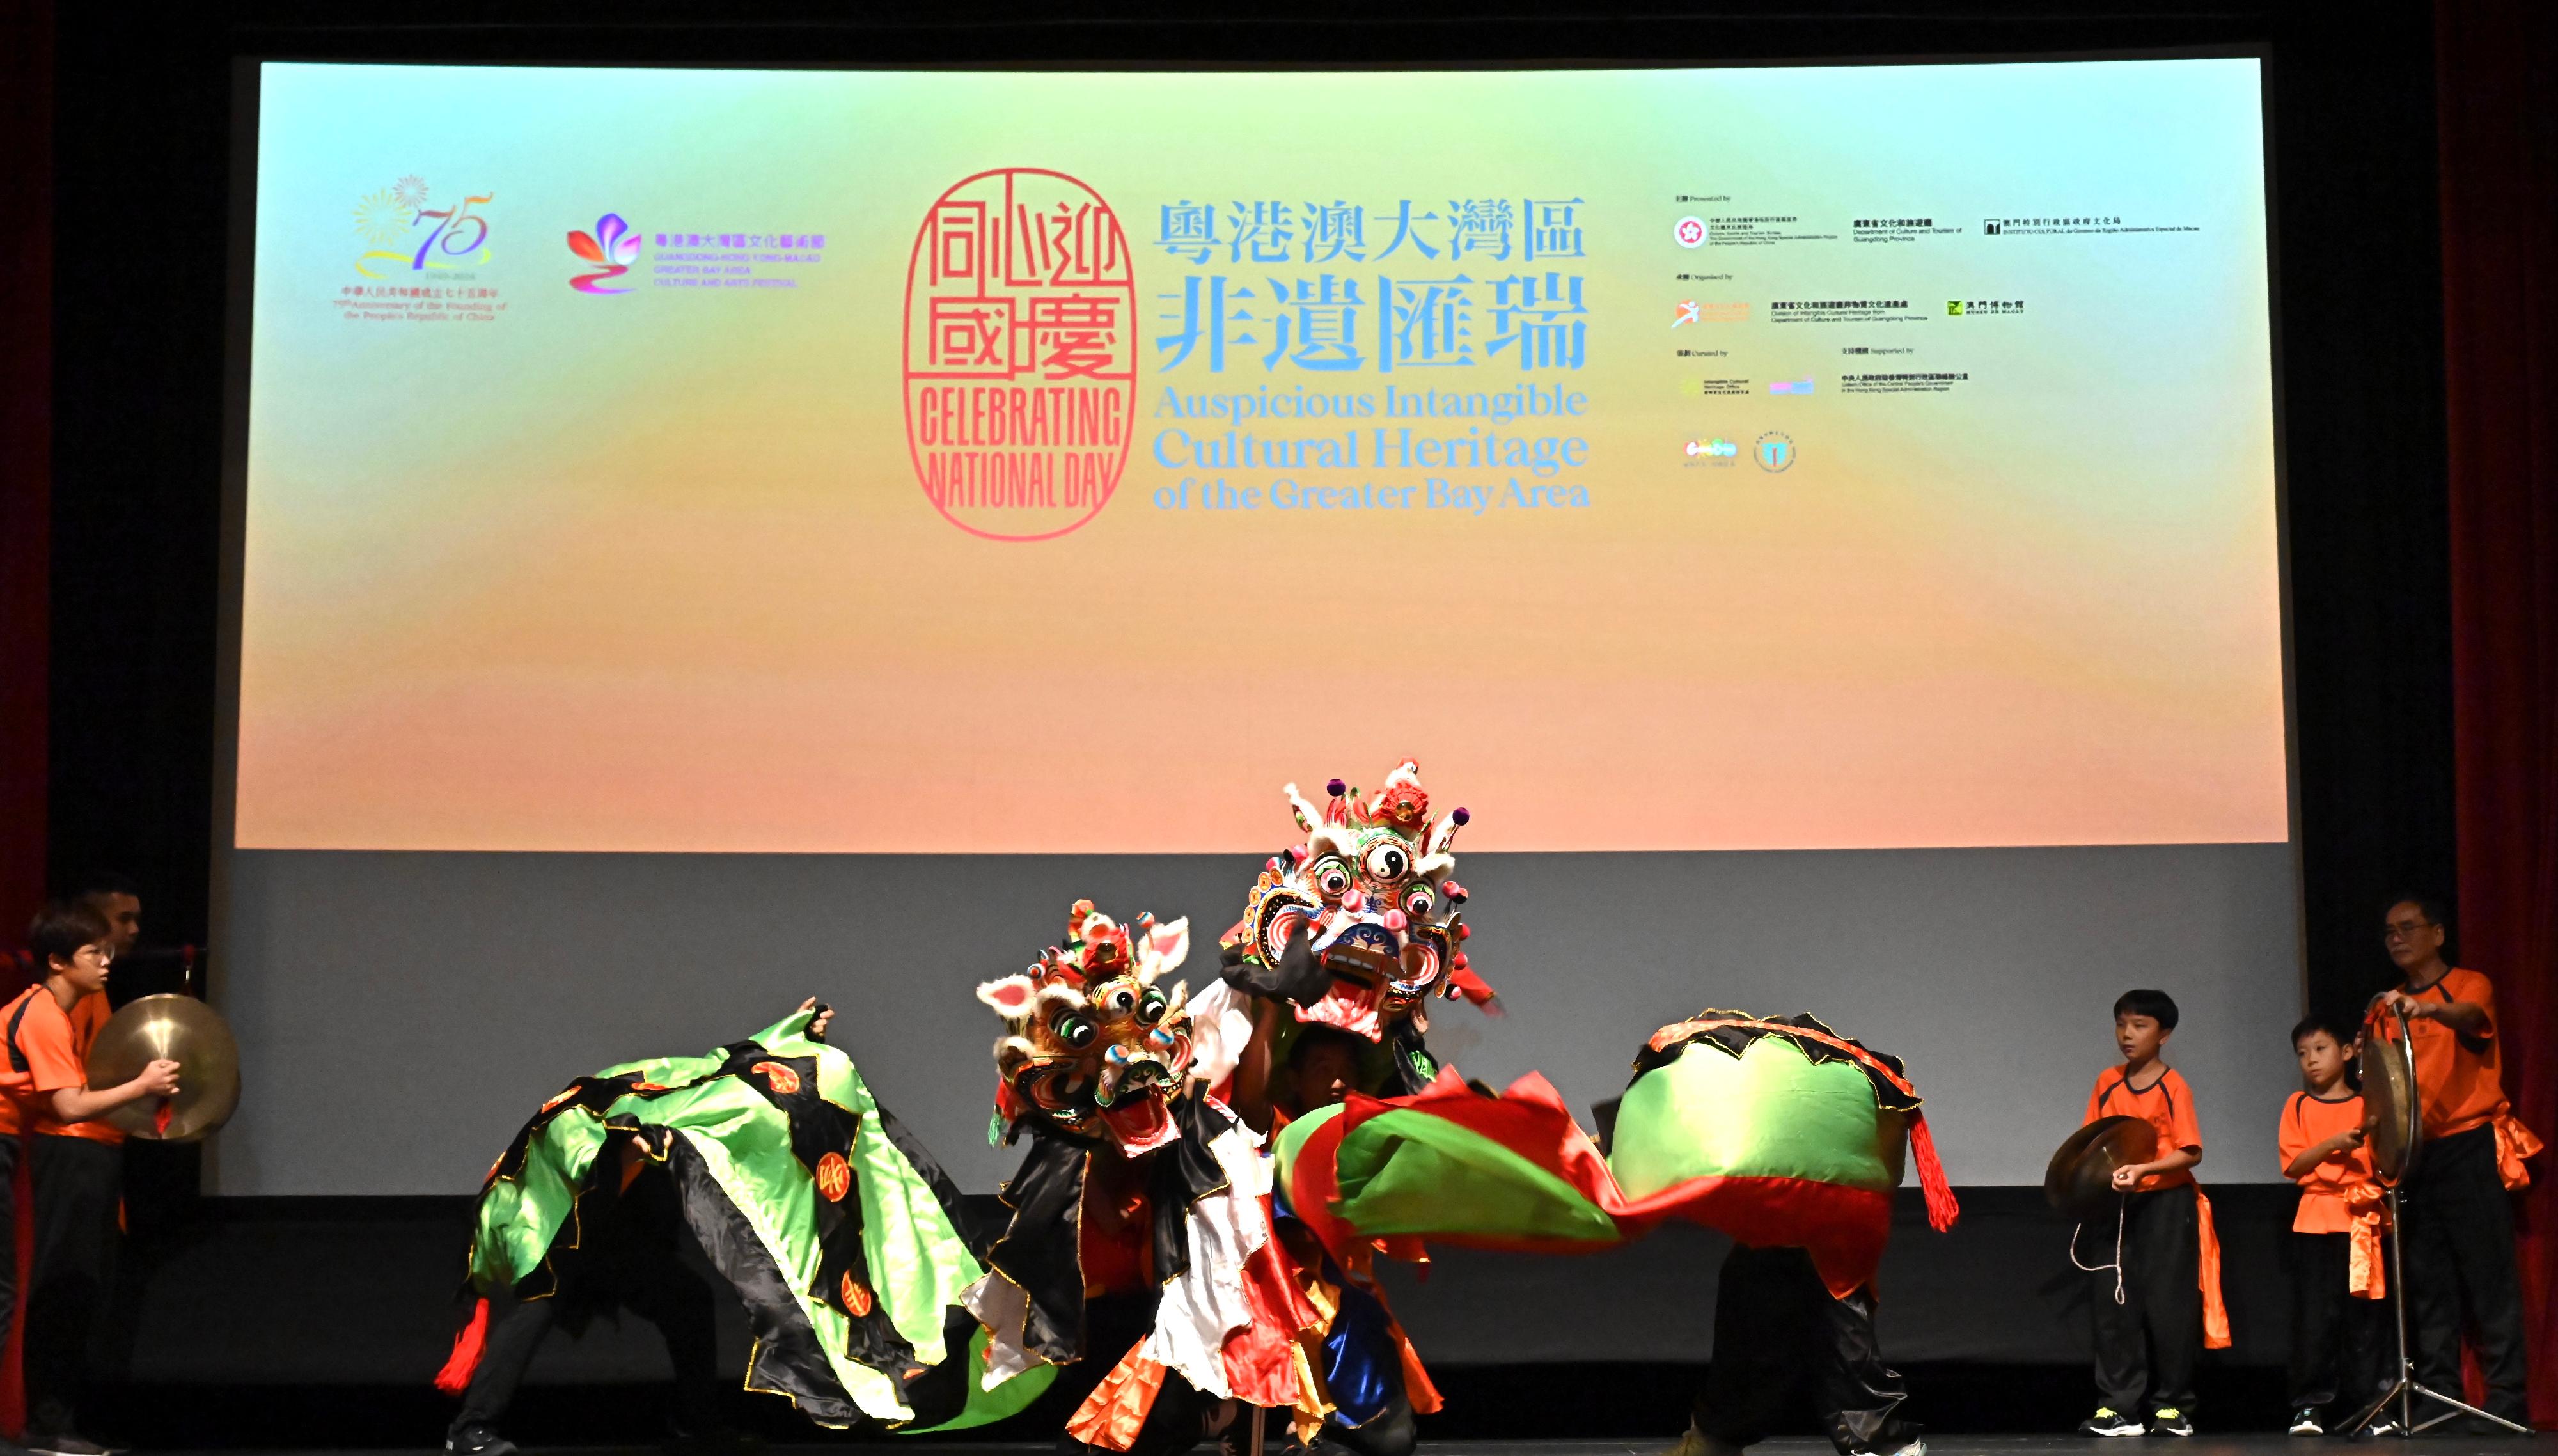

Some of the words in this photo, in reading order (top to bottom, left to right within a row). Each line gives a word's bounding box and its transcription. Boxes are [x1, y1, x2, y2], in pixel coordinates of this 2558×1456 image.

[1723, 195, 1731, 203] by
[412, 191, 493, 270] 75
[1153, 197, 1587, 265] 粵港澳大灣區
[929, 294, 1129, 380] 國慶
[1155, 271, 1589, 373] 非遺匯瑞
[920, 387, 1120, 446] CELEBRATING
[1153, 384, 1375, 426] Auspicious
[1385, 383, 1589, 425] Intangible
[928, 451, 1057, 509] NATIONAL
[1065, 451, 1115, 509] DAY
[1153, 427, 1361, 469] Cultural
[1372, 426, 1589, 478] Heritage
[1153, 476, 1197, 510] of
[1201, 478, 1262, 510] the
[1269, 478, 1416, 510] Greater
[1426, 478, 1494, 517] Bay
[1500, 478, 1590, 508] Area
